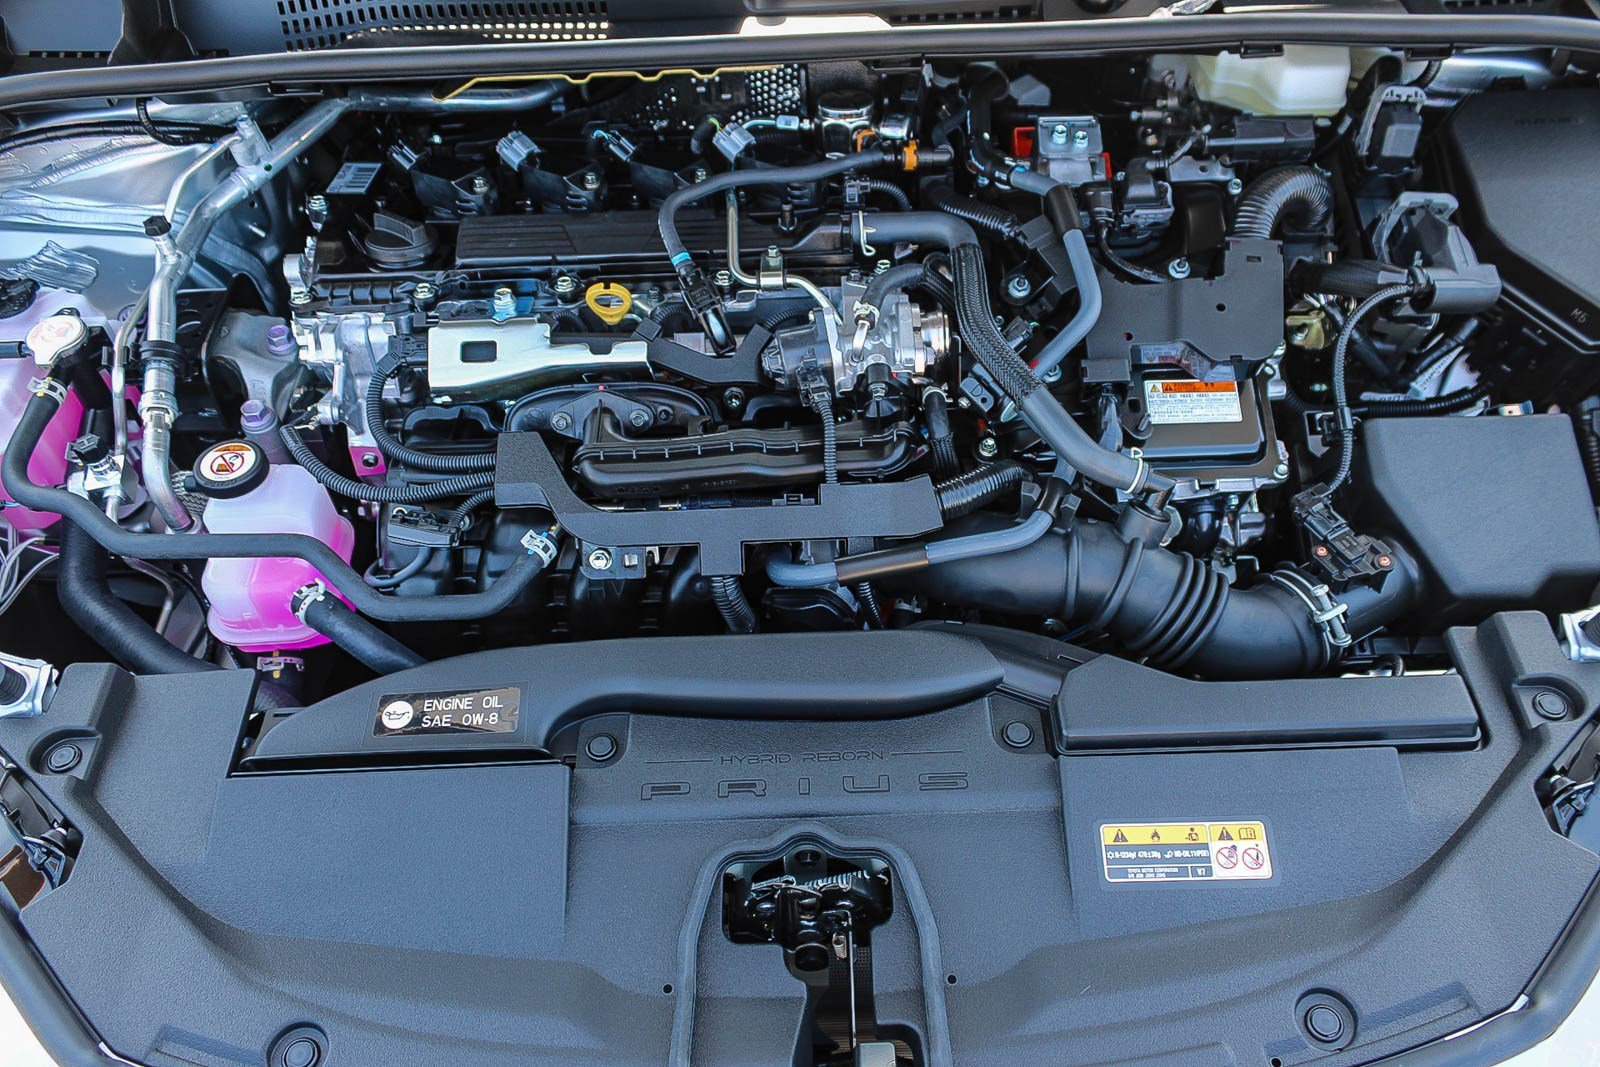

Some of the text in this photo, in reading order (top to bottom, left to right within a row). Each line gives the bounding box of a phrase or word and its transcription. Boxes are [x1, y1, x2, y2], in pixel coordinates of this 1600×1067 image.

[423, 696, 503, 712] ENGINE OIL
[421, 712, 498, 728] SAE 0W-8
[720, 750, 884, 765] HYBRID REBORN
[640, 772, 969, 800] PRIUS
